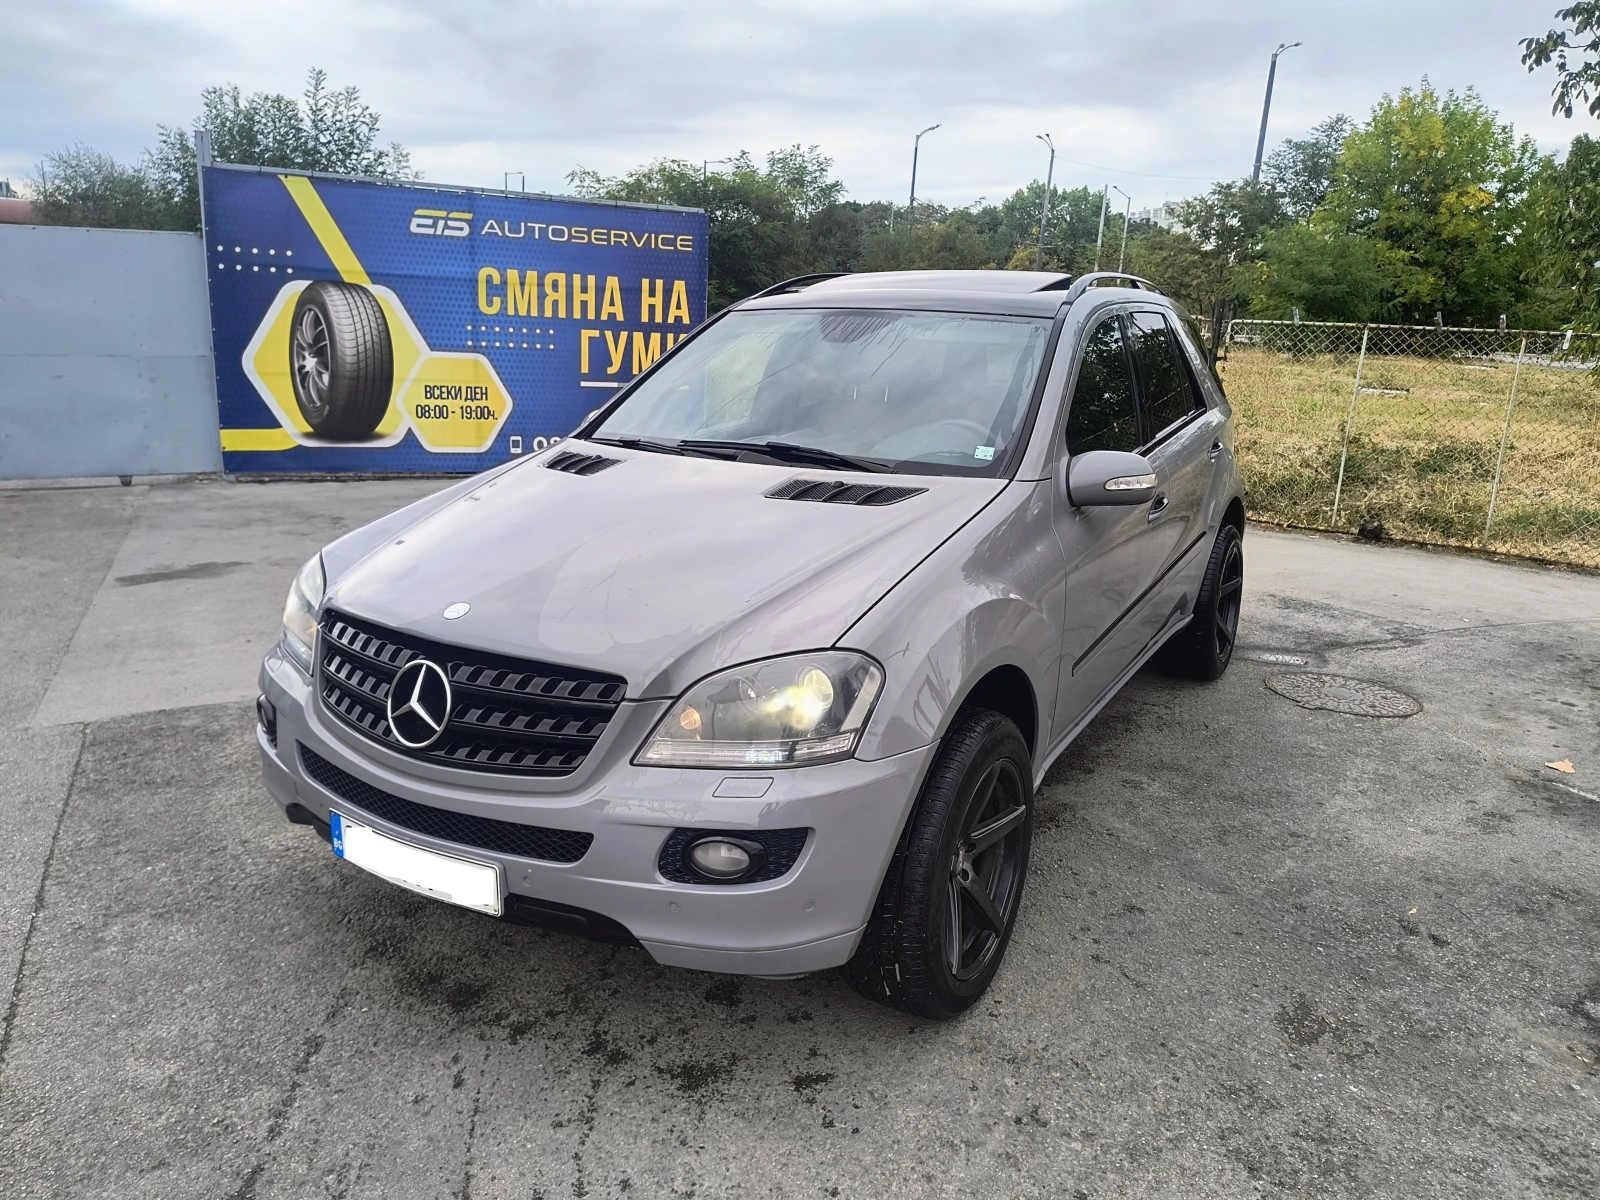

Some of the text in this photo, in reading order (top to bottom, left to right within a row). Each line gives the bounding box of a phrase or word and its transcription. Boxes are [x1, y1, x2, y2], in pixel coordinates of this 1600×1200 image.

[481, 219, 693, 251] AUTOSERVICE
[477, 266, 691, 324] СМЯНА НА
[424, 384, 489, 403] ВСЕКИ ДЕН
[415, 404, 448, 420] 08:00
[459, 405, 498, 421] 19:00ч.
